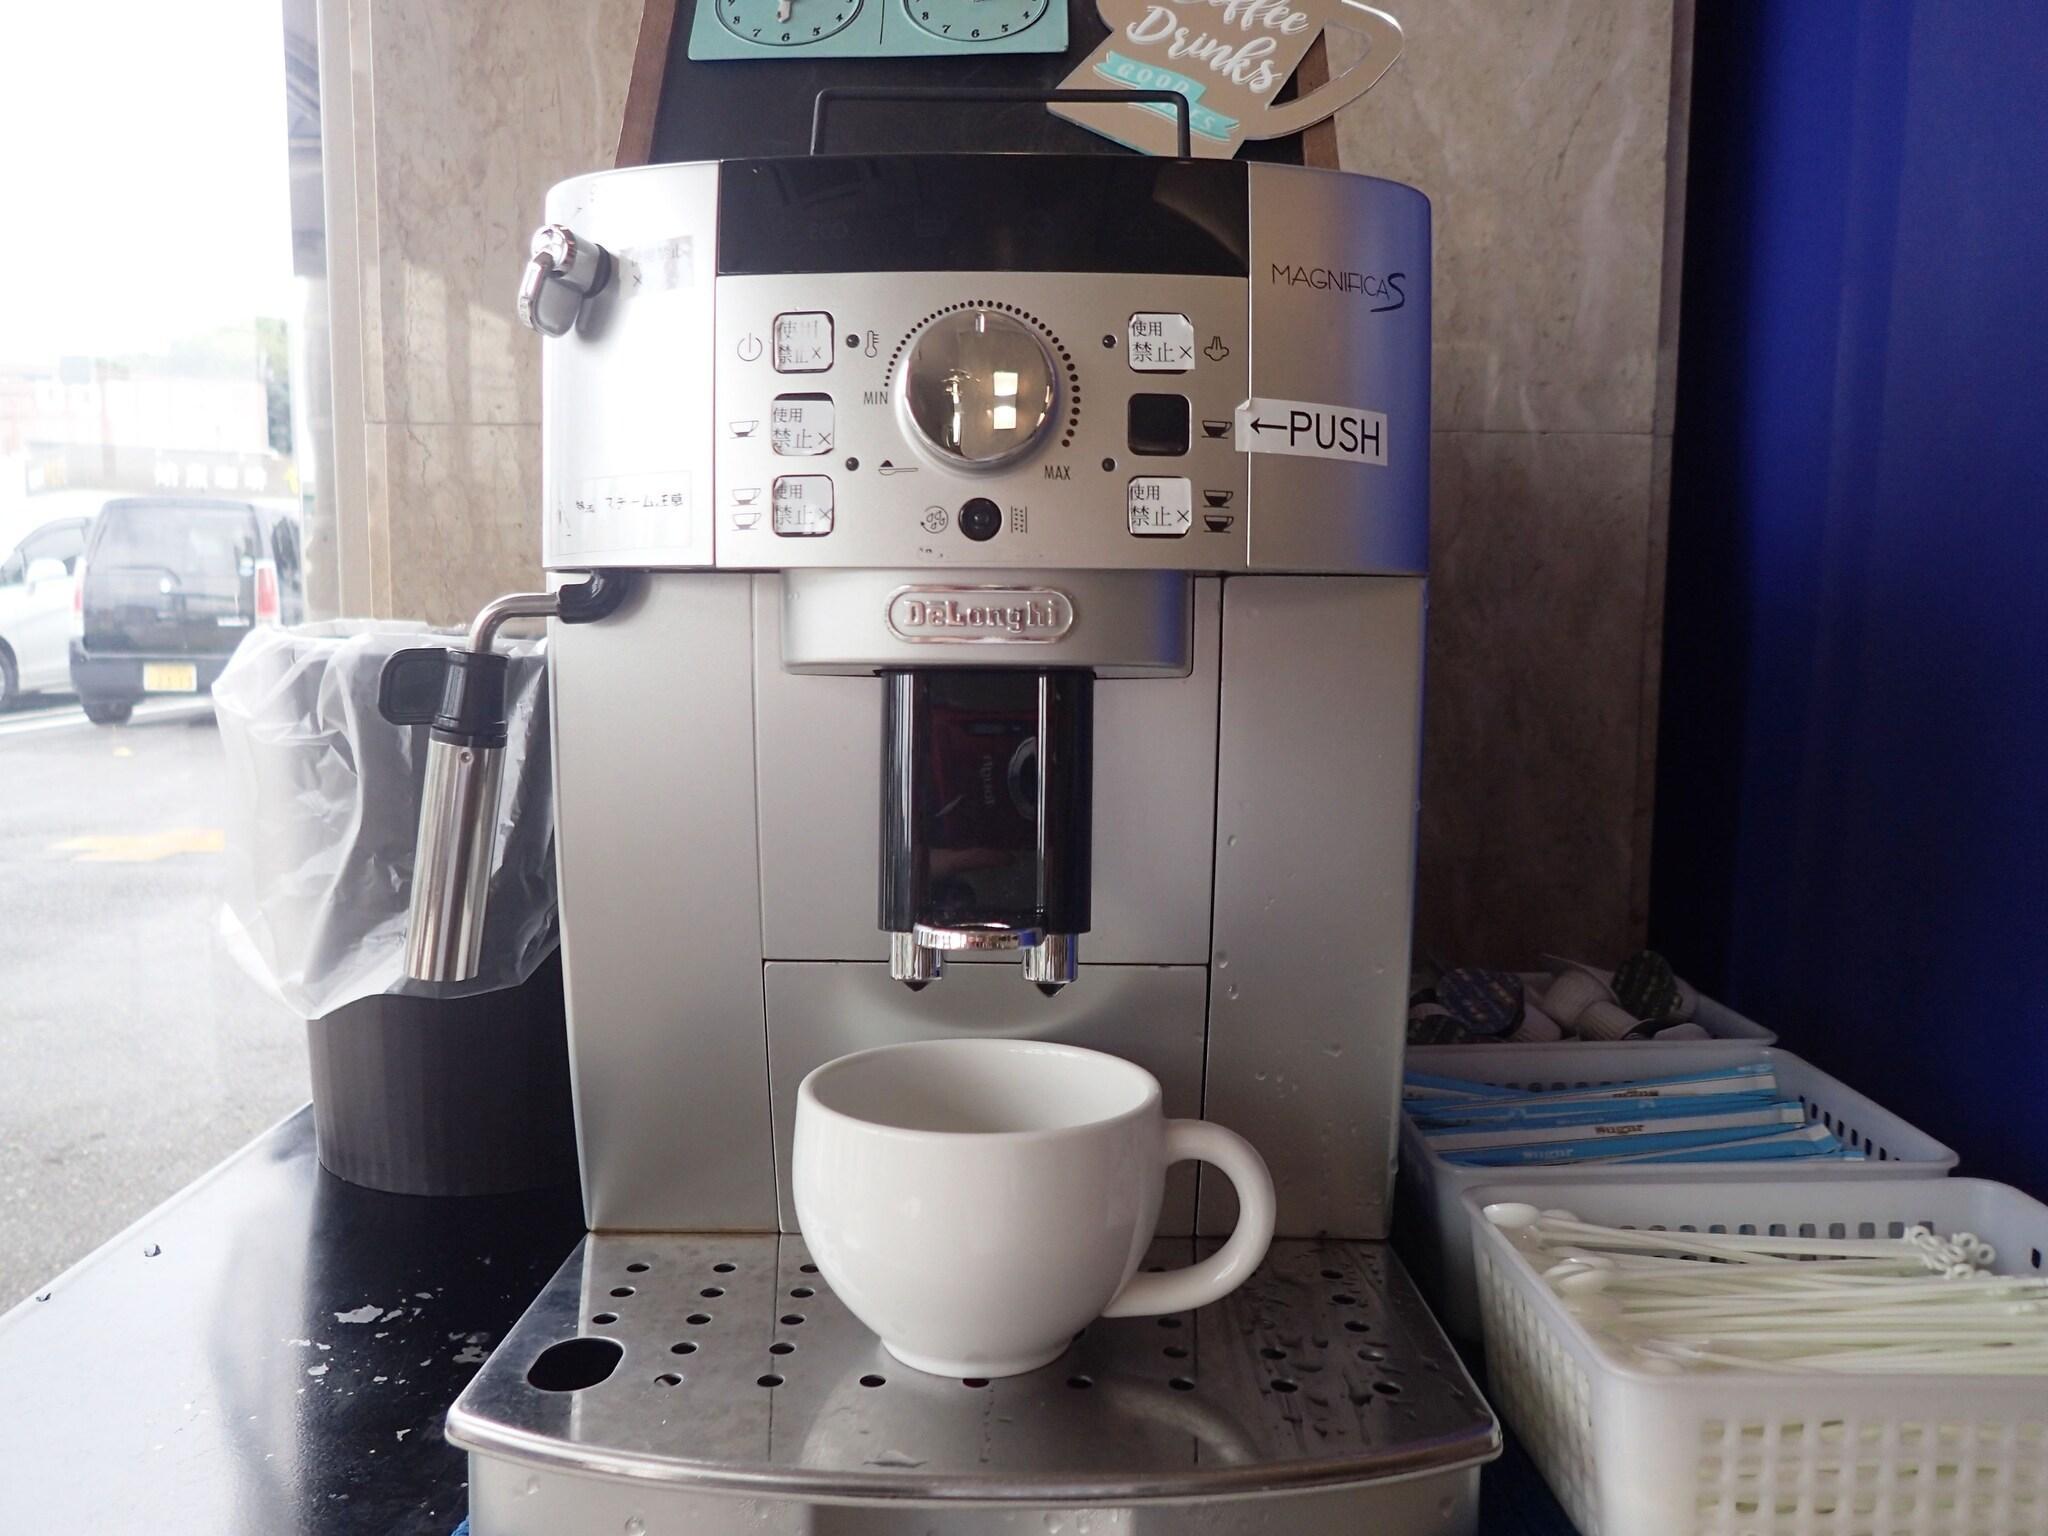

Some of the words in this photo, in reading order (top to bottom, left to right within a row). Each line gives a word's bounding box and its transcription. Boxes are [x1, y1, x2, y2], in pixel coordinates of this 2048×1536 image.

[752, 28, 763, 38] 7
[812, 27, 821, 37] 5
[942, 24, 953, 34] 7
[971, 29, 981, 39] 6
[1000, 24, 1009, 33] 5
[781, 32, 791, 42] 6
[1126, 5, 1283, 94] Drinks
[1132, 320, 1162, 337] 使用
[863, 391, 889, 405] MIN
[773, 407, 803, 424] 使用
[1290, 410, 1380, 456] PUSH
[1044, 465, 1071, 481] MAX
[1130, 484, 1160, 501] 使用
